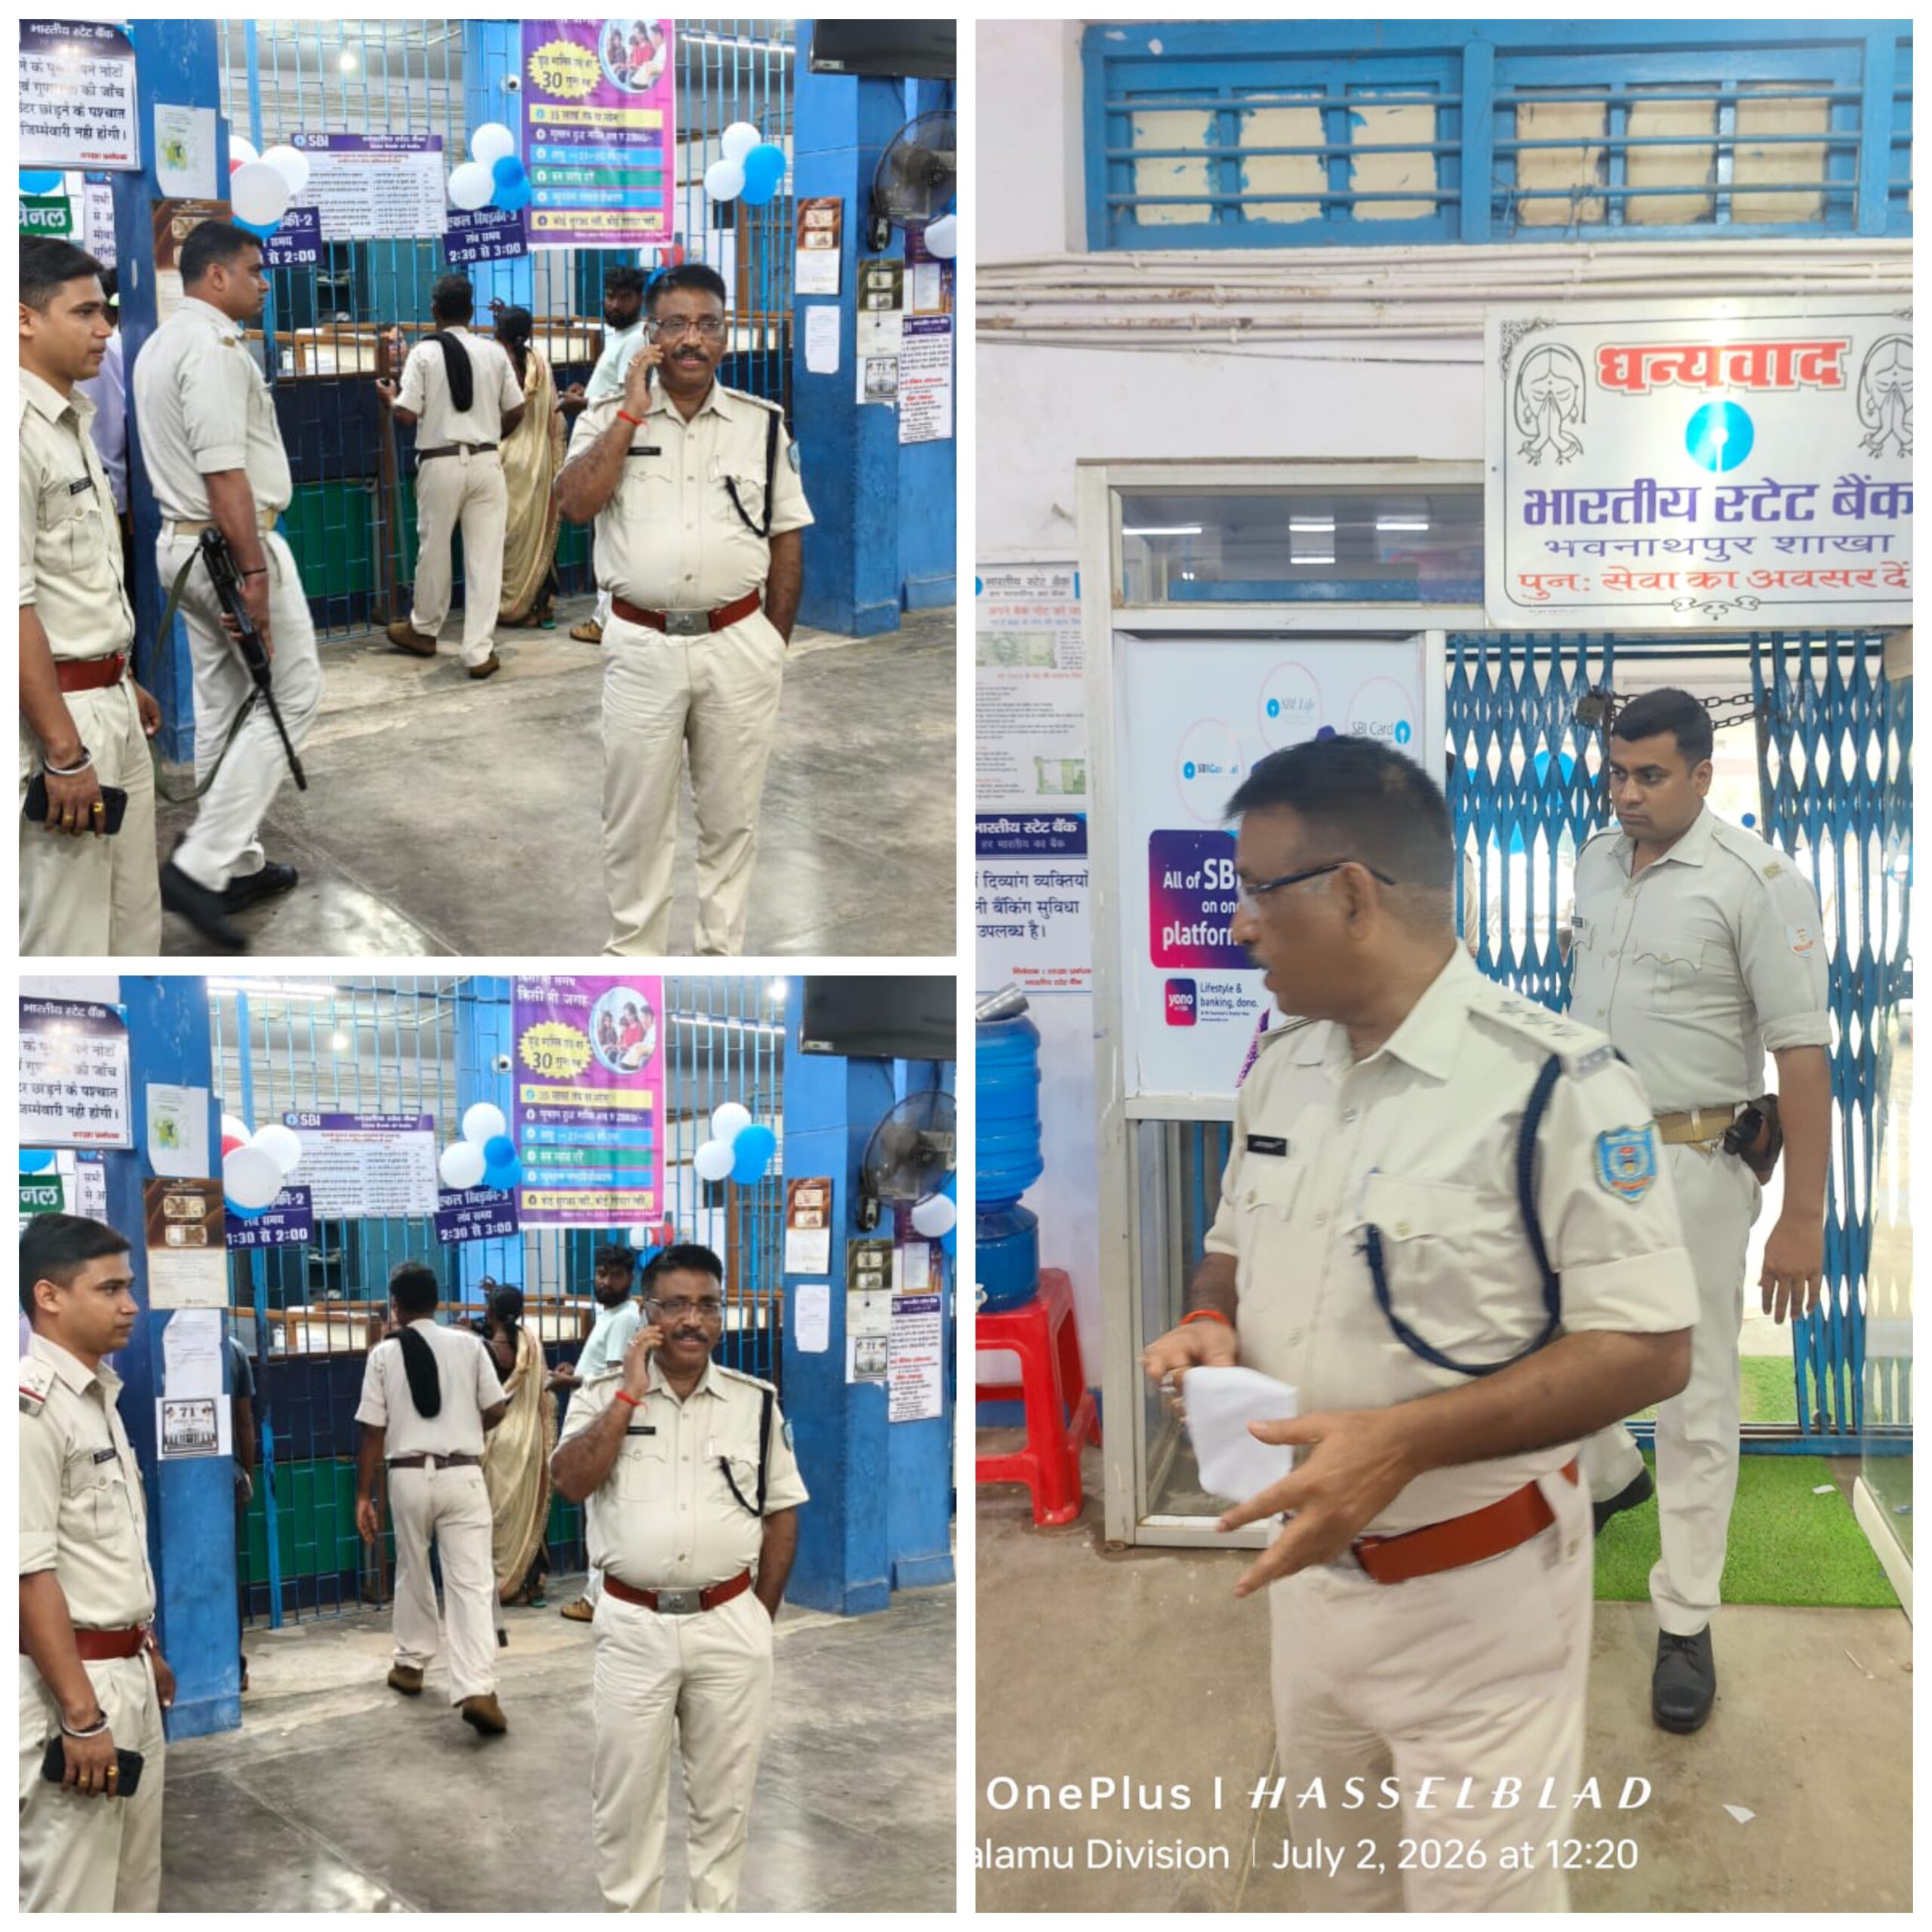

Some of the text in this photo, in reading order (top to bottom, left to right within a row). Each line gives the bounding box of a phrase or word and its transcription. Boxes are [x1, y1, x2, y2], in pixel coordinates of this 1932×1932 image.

[30, 23, 69, 35] भारतीय
[72, 25, 93, 37] स्टेट
[543, 71, 562, 89] 30
[308, 135, 329, 148] SBI
[284, 249, 315, 263] 2:00
[449, 248, 476, 262] 2:30
[494, 242, 521, 256] 3:00
[1596, 339, 1849, 392] धन्यवाद
[1524, 474, 1913, 526] भारतीय स्टेट बैंक
[1544, 535, 1895, 562] भवनाथपुर शाखा
[1601, 566, 1679, 590] सेवा
[1685, 571, 1740, 589] का
[1746, 569, 1877, 590] अवसर
[1878, 561, 1911, 589] दें
[1352, 721, 1393, 736] SBI Card
[1023, 819, 1051, 833] स्टेट
[1052, 818, 1078, 832] बैंक
[983, 870, 1029, 891] दिव्यांग
[1163, 871, 1183, 889] All
[1186, 871, 1201, 889] of
[992, 896, 1032, 915] बैंकिंग
[1035, 896, 1080, 919] सुविधा
[1201, 901, 1217, 913] on
[977, 925, 1025, 938] उपलब्ध
[1201, 983, 1242, 995] Lifestyle &
[1168, 994, 1193, 1007] yono
[1201, 997, 1234, 1009] banking,
[1236, 998, 1259, 1008] dono.
[23, 1002, 106, 1018] भारतीय स्टेट बैंक
[533, 1052, 552, 1069] 30
[300, 1115, 321, 1127] SBI
[226, 1231, 255, 1245] 1:30
[275, 1228, 309, 1242] 2:00
[440, 1227, 468, 1241] 2:30
[485, 1221, 512, 1235] 3:00
